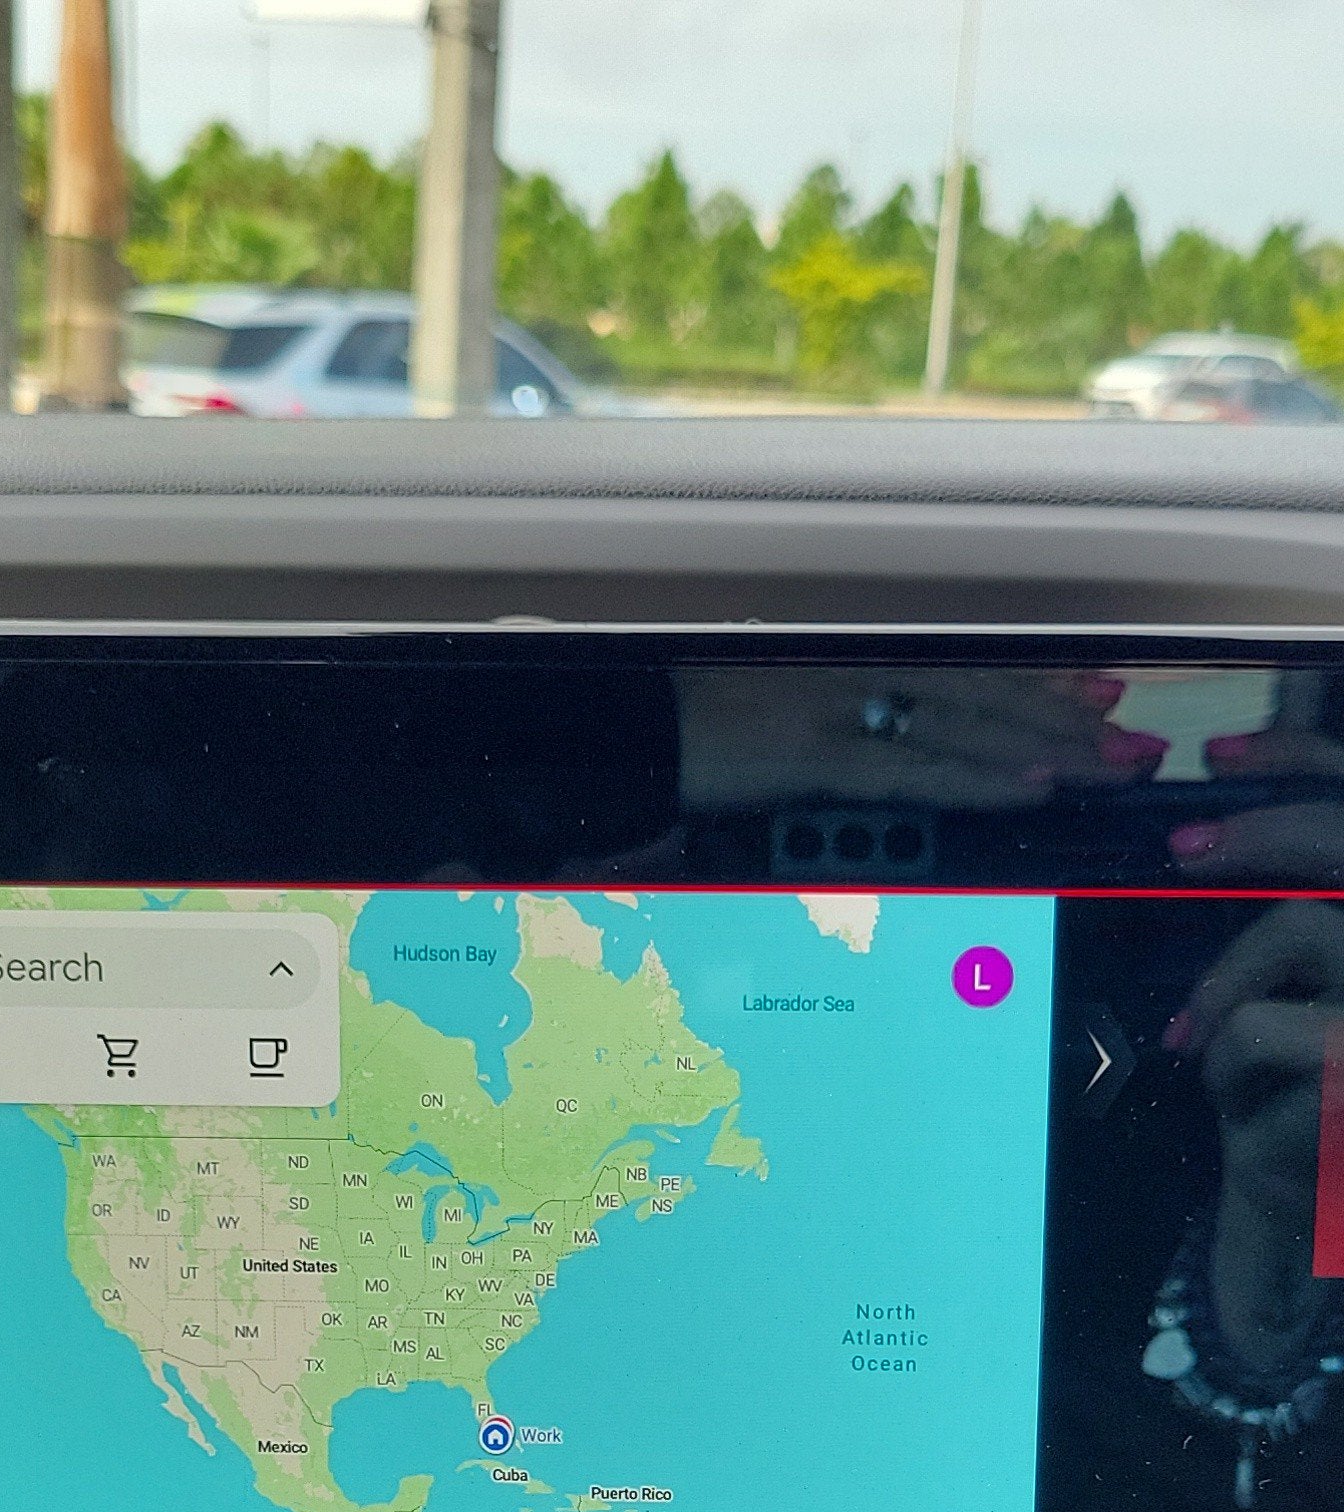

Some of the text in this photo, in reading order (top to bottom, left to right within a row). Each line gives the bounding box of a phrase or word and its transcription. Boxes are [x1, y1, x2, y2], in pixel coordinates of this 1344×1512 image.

[392, 945, 498, 966] Hudson Bay
[973, 963, 992, 991] L
[742, 994, 855, 1013] Labrador Sea
[676, 1057, 697, 1071] NL
[420, 1094, 443, 1108] ON
[555, 1099, 578, 1113] QC
[92, 1155, 116, 1168] WA
[288, 1156, 309, 1169] ND
[197, 1162, 219, 1175] MT
[626, 1167, 647, 1181] NB
[342, 1173, 367, 1187] MN
[661, 1178, 680, 1191] PE
[289, 1197, 309, 1210] SD
[395, 1196, 413, 1209] WI
[596, 1195, 619, 1208] ME
[651, 1199, 672, 1213] NS
[92, 1204, 112, 1217] OR
[156, 1209, 170, 1222] ID
[444, 1209, 462, 1222] MI
[217, 1216, 240, 1229] WY
[533, 1222, 554, 1235] NY
[359, 1232, 375, 1245] IA
[573, 1231, 598, 1244] MA
[299, 1238, 319, 1251] NE
[399, 1245, 411, 1258] IL
[461, 1251, 483, 1265] OH
[513, 1249, 532, 1263] PA
[129, 1257, 150, 1270] NV
[242, 1258, 338, 1274] United States
[432, 1256, 447, 1270] IN
[180, 1267, 199, 1280] UT
[365, 1279, 389, 1293] MO
[478, 1279, 502, 1293] WV
[535, 1274, 555, 1287] DE
[102, 1289, 122, 1302] CA
[445, 1288, 465, 1301] KY
[514, 1292, 534, 1306] VA
[856, 1303, 916, 1320] North
[321, 1313, 343, 1327] OK
[367, 1315, 388, 1328] AR
[424, 1312, 445, 1325] TN
[501, 1314, 523, 1328] NC
[181, 1325, 201, 1338] AZ
[234, 1325, 259, 1338] NM
[841, 1329, 929, 1346] Atlantic
[393, 1340, 417, 1354] MS
[485, 1338, 506, 1351] SC
[425, 1347, 445, 1361] AL
[306, 1359, 325, 1372] TX
[851, 1355, 917, 1372] Ocean
[376, 1373, 397, 1386] LA
[478, 1403, 493, 1417] FL
[521, 1428, 562, 1443] Work
[258, 1440, 308, 1455] Mexico
[492, 1468, 528, 1482] Cuba
[591, 1486, 672, 1501] Puerto Rico
